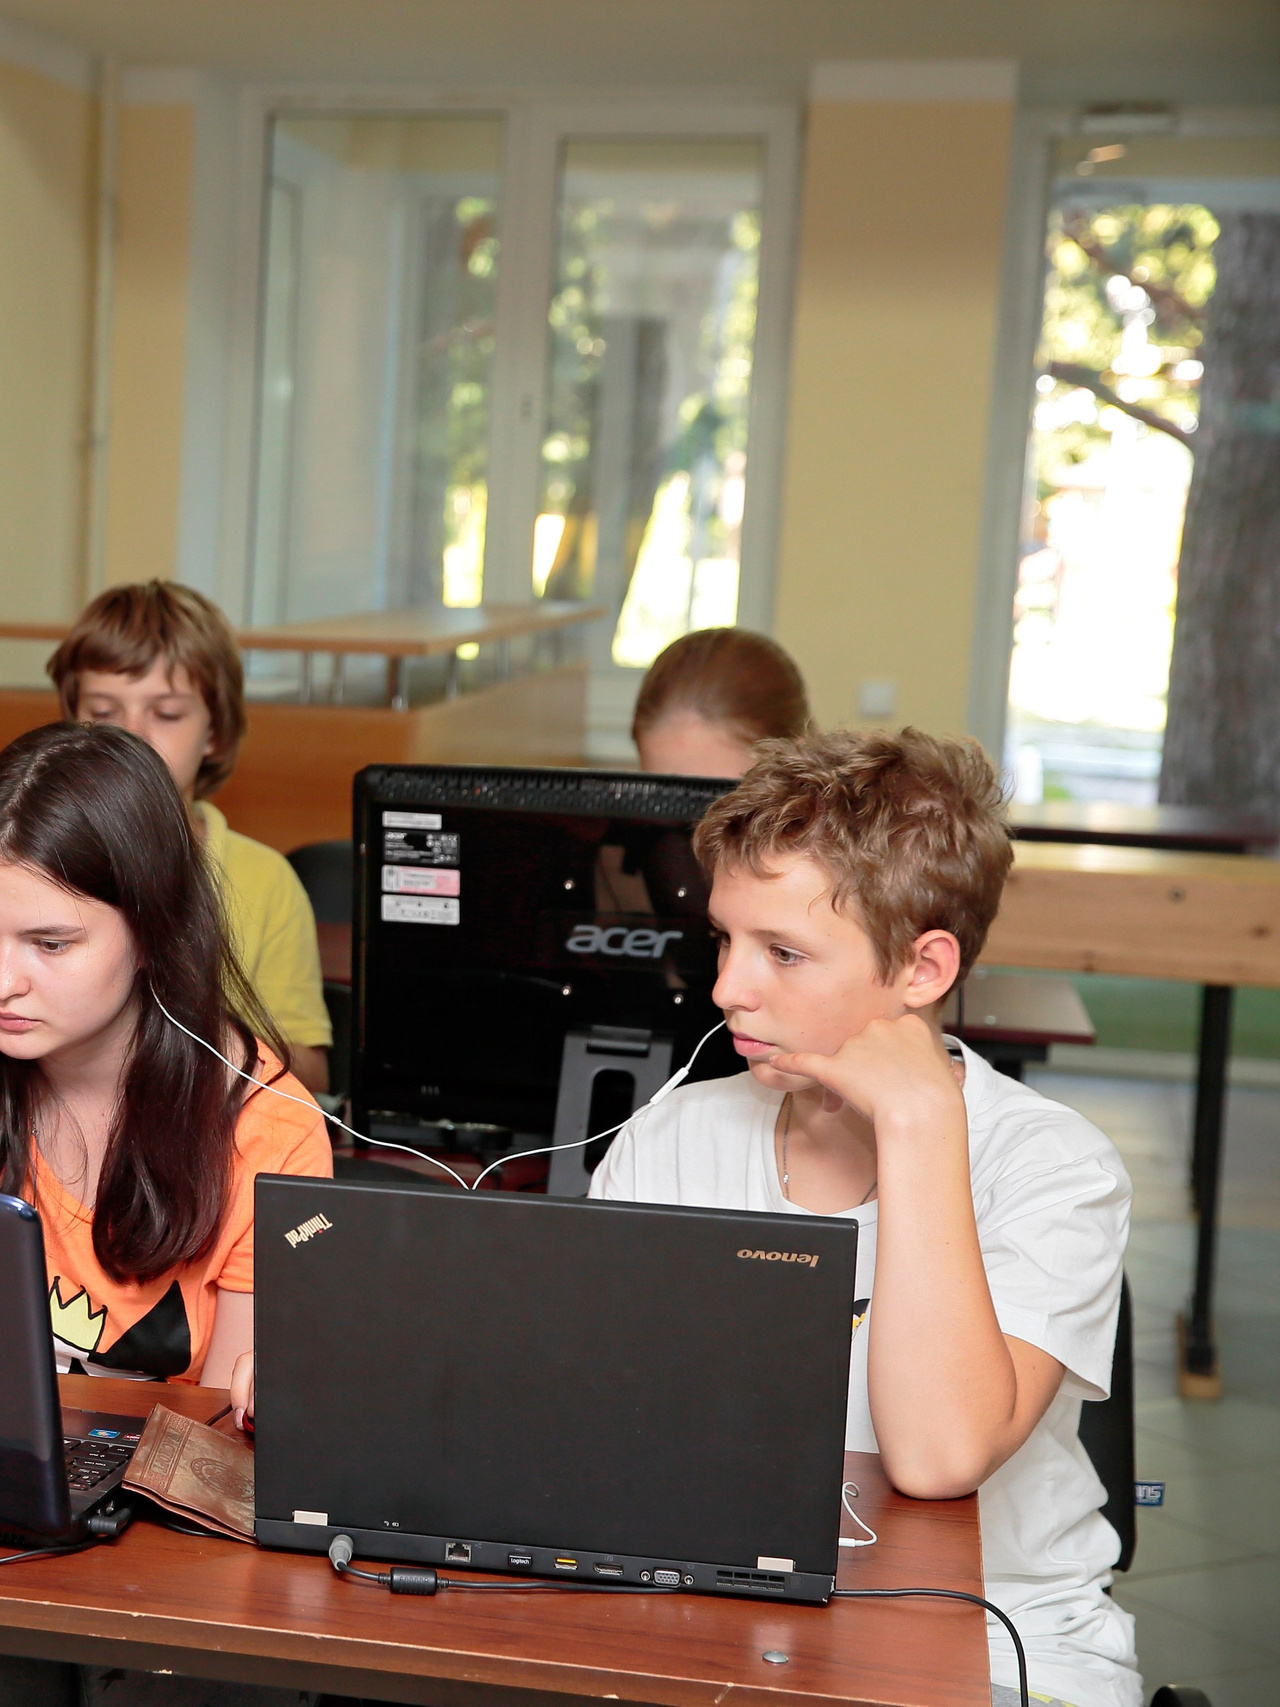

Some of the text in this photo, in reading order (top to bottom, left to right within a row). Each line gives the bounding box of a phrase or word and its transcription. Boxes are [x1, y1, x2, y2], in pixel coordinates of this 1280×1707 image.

[566, 924, 683, 958] acer
[283, 1212, 334, 1249] ThinkPad
[736, 1248, 820, 1268] lenovo
[509, 1558, 531, 1566] Logitech
